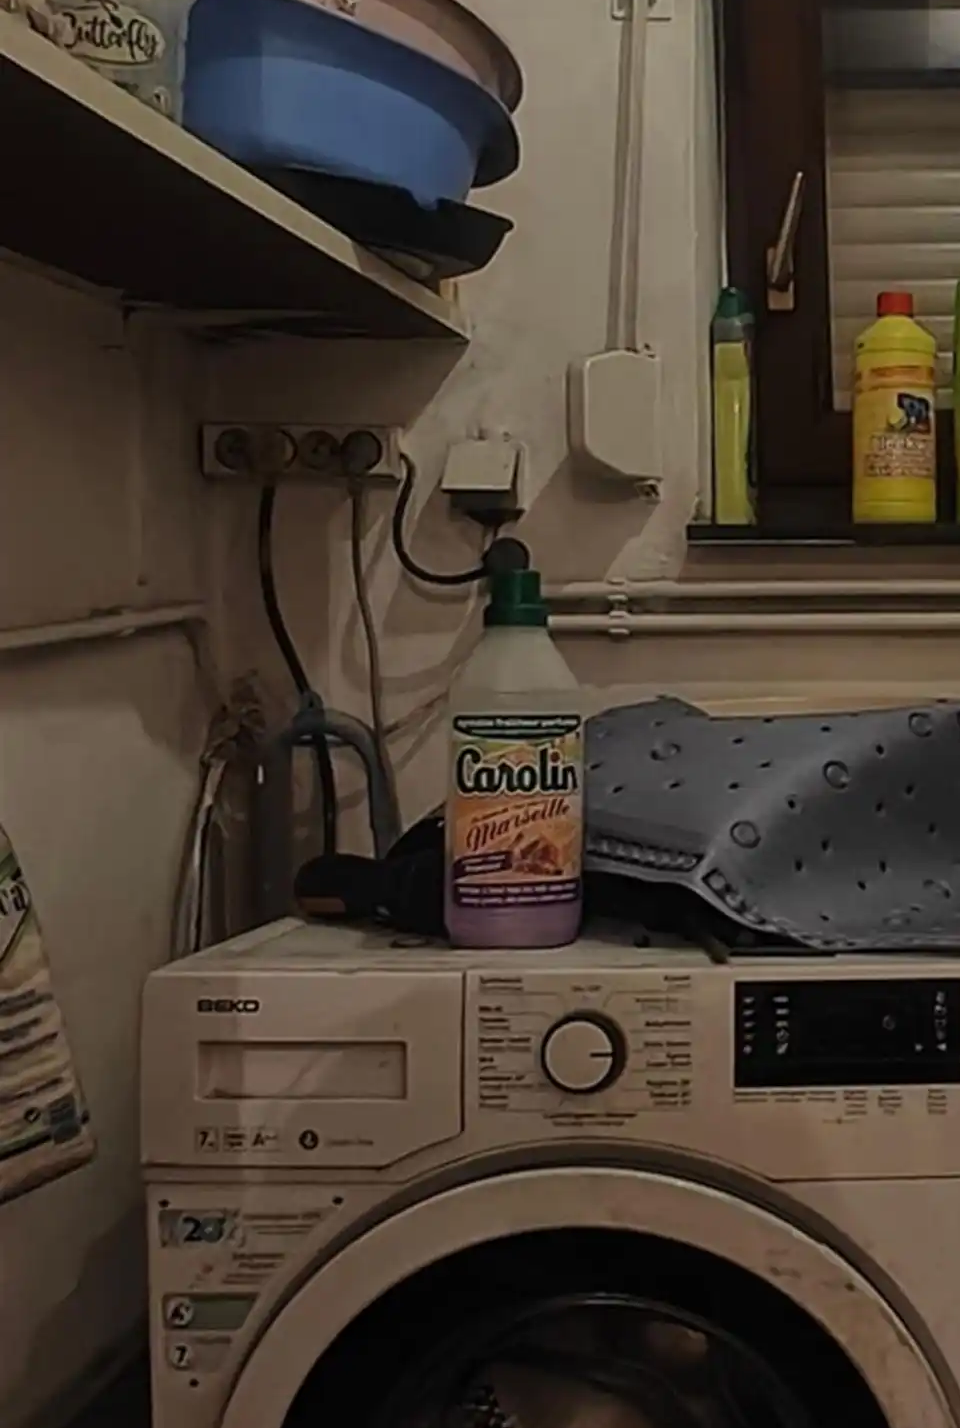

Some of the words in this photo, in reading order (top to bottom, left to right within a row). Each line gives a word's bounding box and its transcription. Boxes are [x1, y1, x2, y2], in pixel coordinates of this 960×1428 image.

[457, 746, 578, 794] Carolin
[465, 797, 571, 851] Marseille
[197, 999, 259, 1012] BEKO
